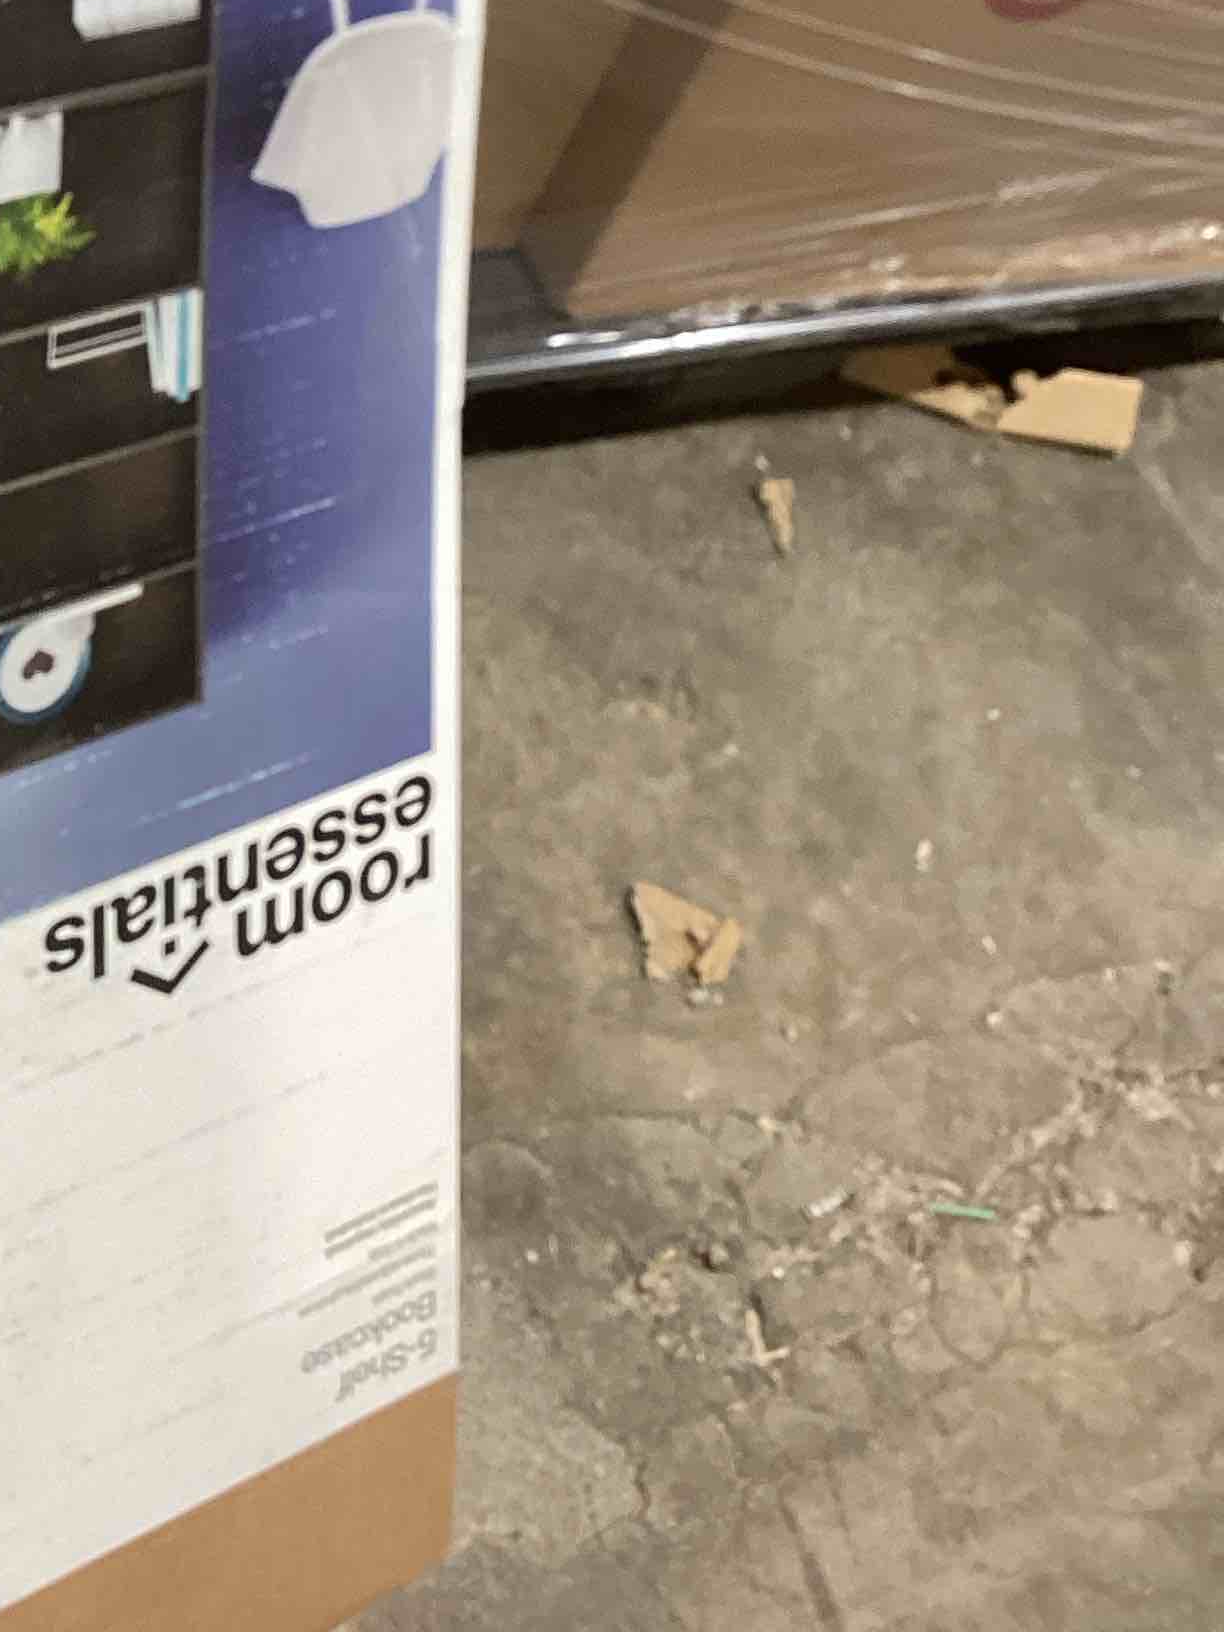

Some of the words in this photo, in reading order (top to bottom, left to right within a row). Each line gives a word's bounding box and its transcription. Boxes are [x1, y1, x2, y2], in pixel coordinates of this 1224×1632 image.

[44, 774, 432, 981] essentials
[234, 828, 432, 960] room
[300, 1290, 438, 1375] Bookcase
